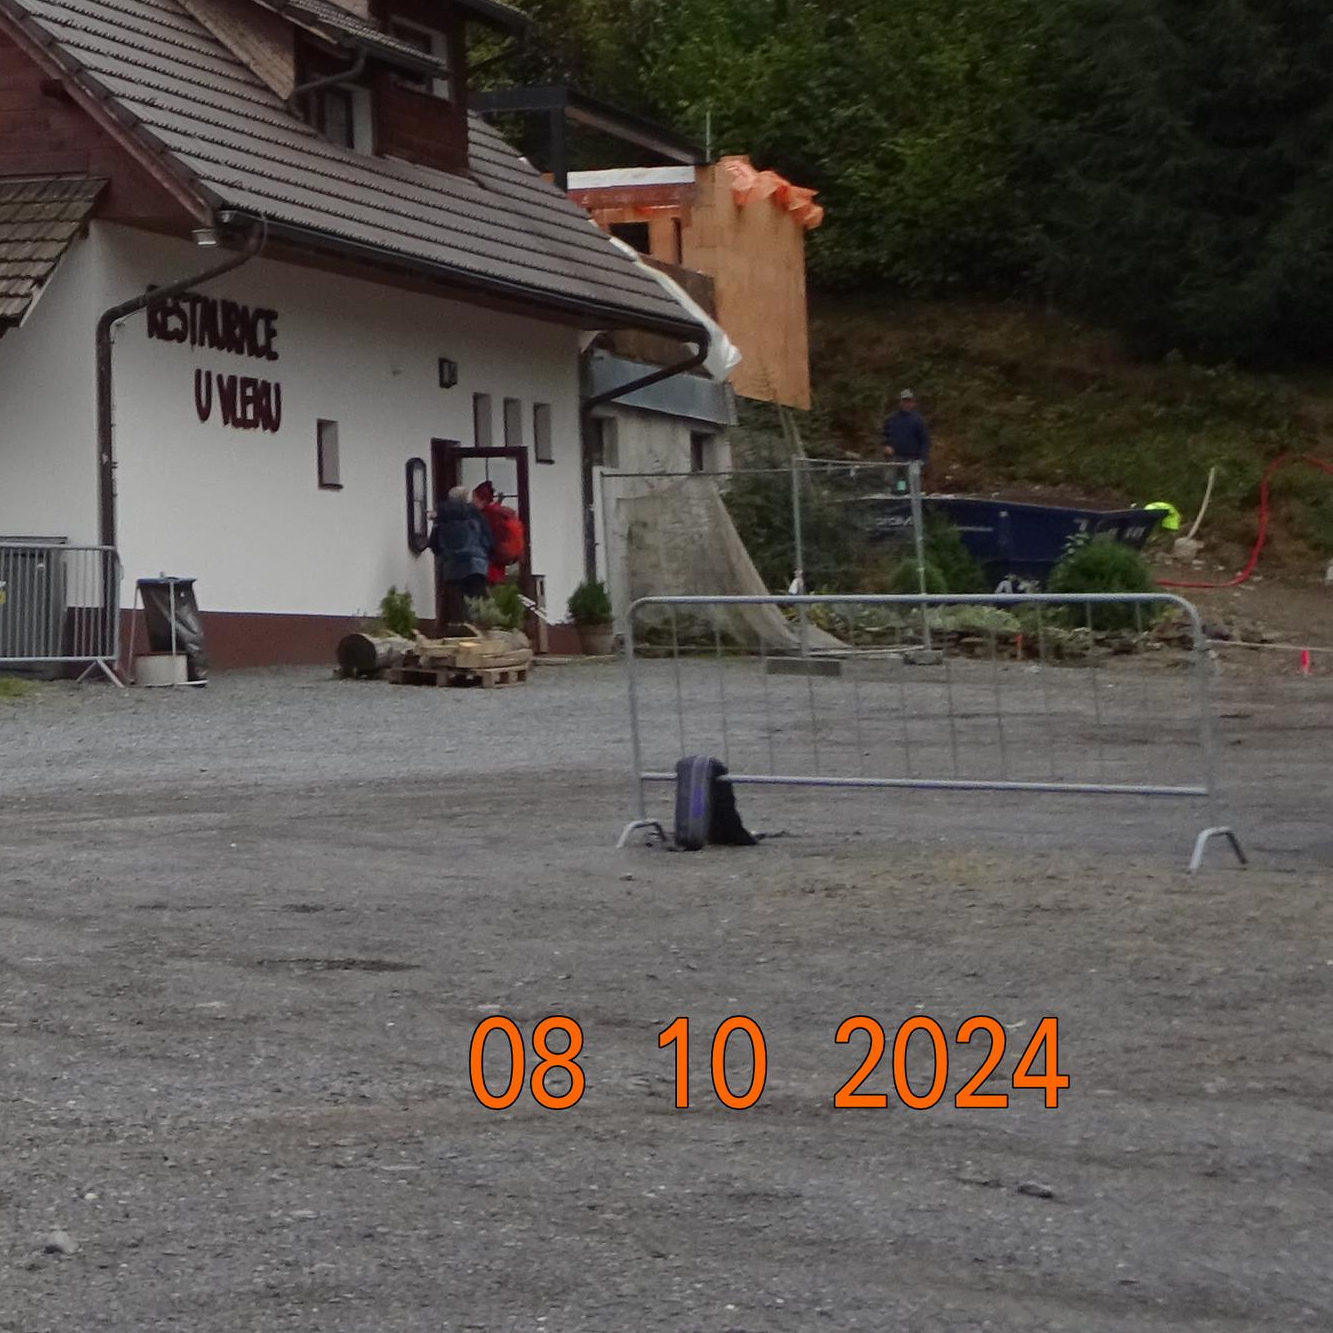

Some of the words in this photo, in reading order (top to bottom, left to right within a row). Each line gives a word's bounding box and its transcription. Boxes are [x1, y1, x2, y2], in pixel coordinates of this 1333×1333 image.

[147, 285, 280, 361] RESTAURACE
[194, 368, 212, 423] U
[216, 373, 282, 433] VLEKU
